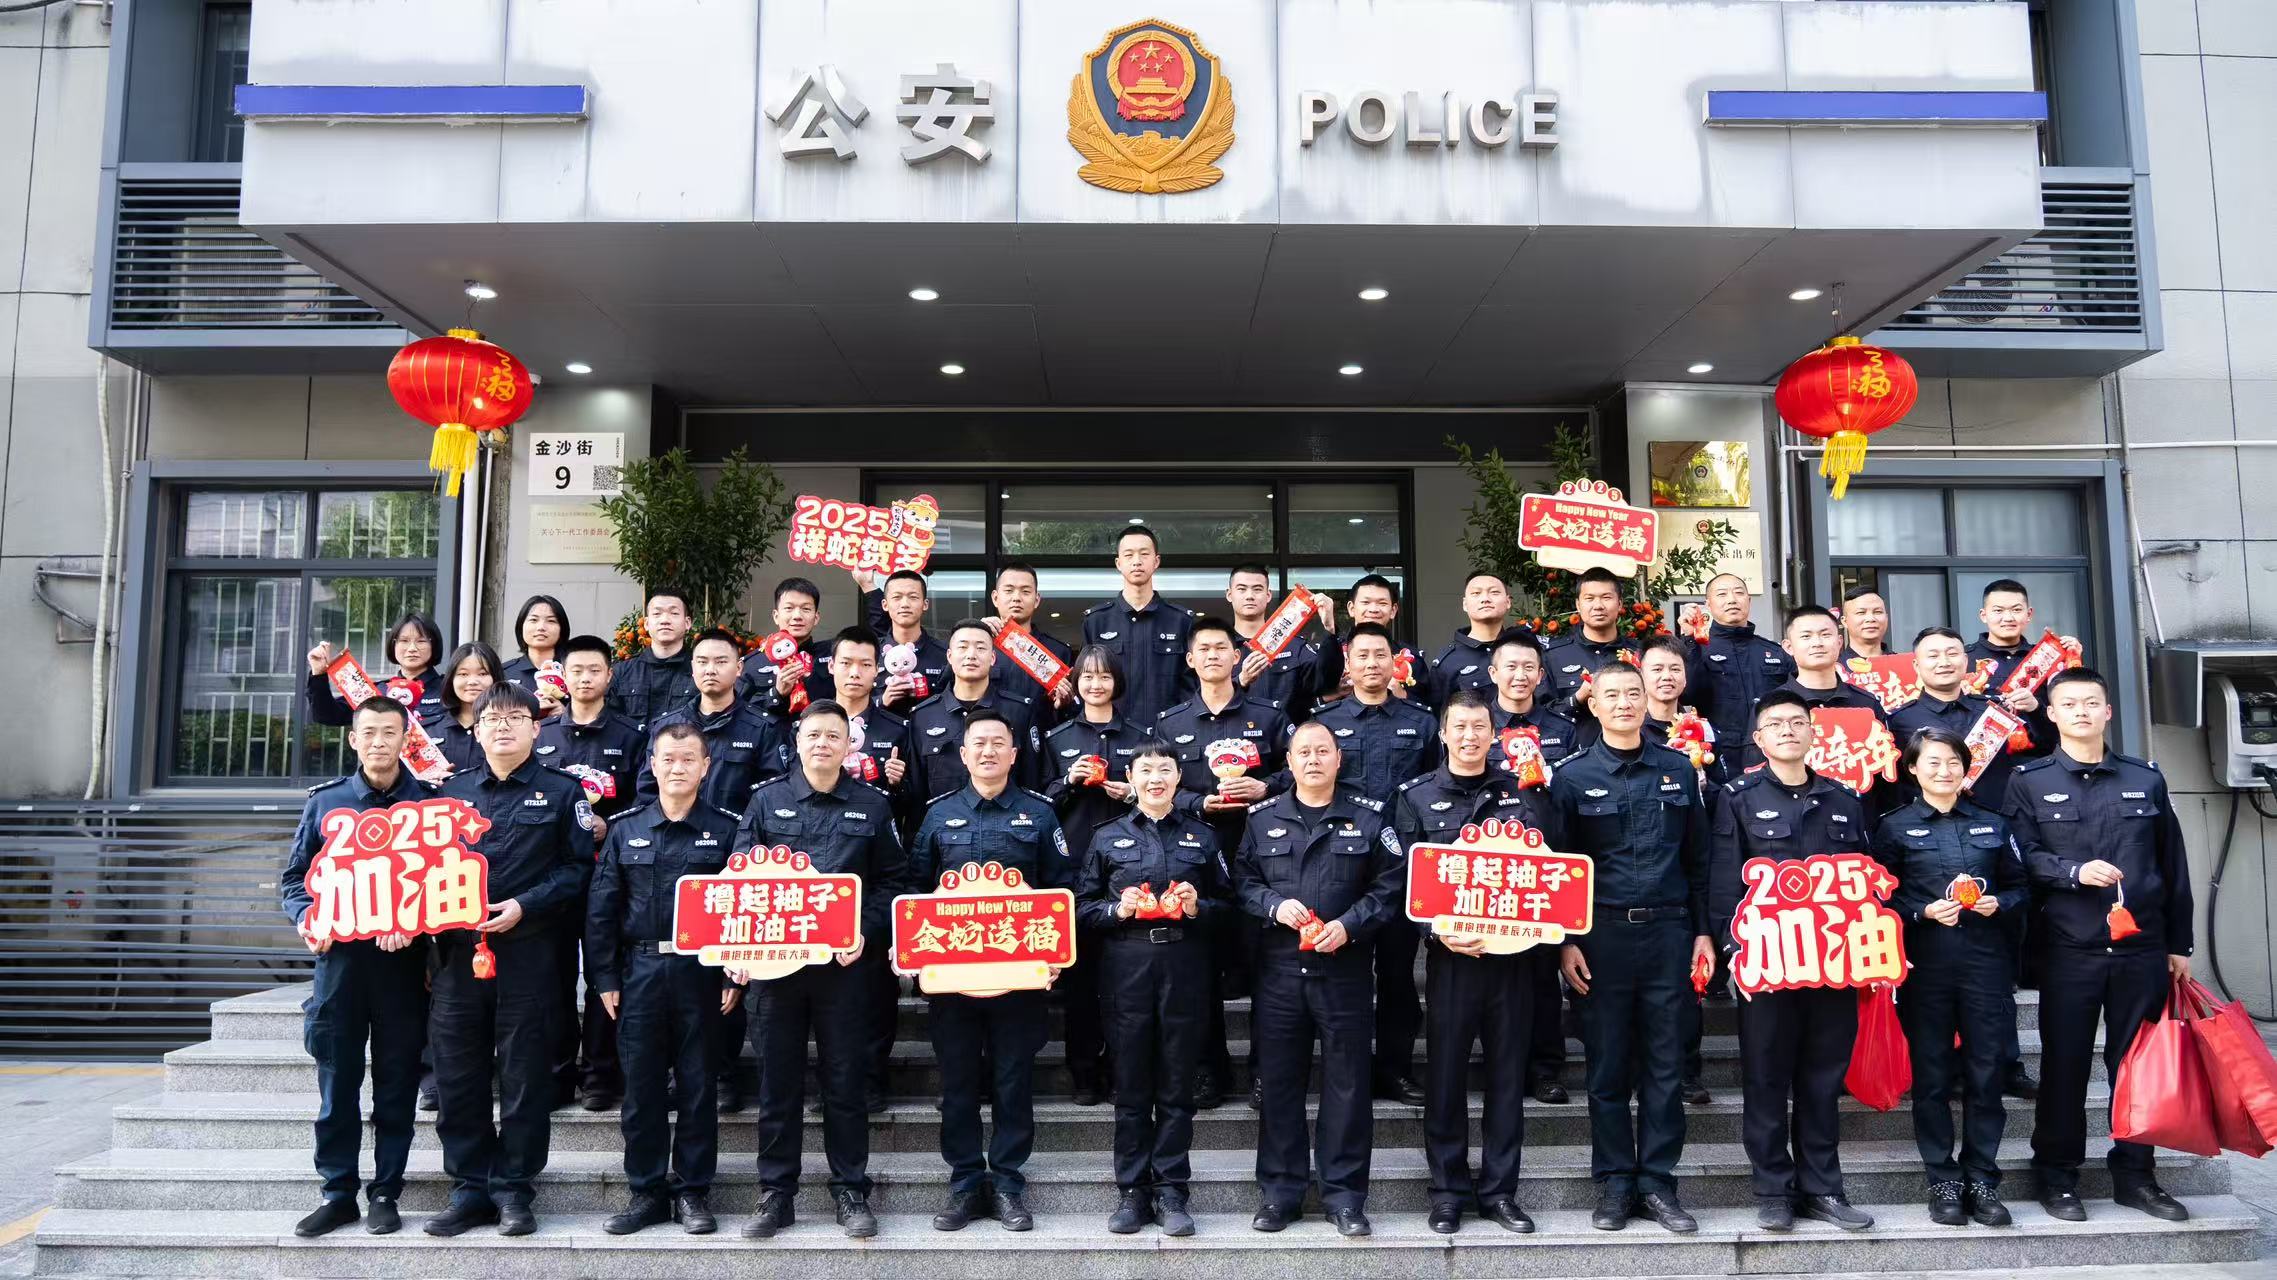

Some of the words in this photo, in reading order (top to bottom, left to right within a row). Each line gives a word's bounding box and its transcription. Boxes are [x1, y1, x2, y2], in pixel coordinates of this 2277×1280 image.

[764, 63, 996, 168] 公安
[1299, 89, 1560, 151] POLICE
[1851, 351, 1892, 398] 福
[535, 440, 593, 456] 金沙街
[555, 465, 571, 490] 9
[1563, 480, 1620, 501] 2025
[797, 500, 890, 537] 2025
[1555, 503, 1585, 516] Happy
[1586, 506, 1607, 518] New
[1607, 509, 1629, 521] Year
[1533, 512, 1647, 553] 金蛇送福
[1853, 672, 1881, 685] 2025
[327, 805, 453, 857] 2025
[1466, 819, 1538, 846] 2025
[732, 847, 806, 870] 2025
[1437, 853, 1572, 892] 撸起袖子
[946, 864, 1017, 887] 2025
[1749, 860, 1868, 906] 2025
[310, 847, 482, 940] 加油
[704, 883, 838, 914] 撸起袖子
[936, 902, 975, 916] Happy
[977, 901, 1004, 914] New
[1005, 899, 1034, 913] Year
[1452, 885, 1552, 921] 加油干
[719, 913, 819, 943] 加油干
[911, 915, 1061, 954] 金蛇送福
[1453, 921, 1496, 935] 拥抱理想
[1500, 925, 1543, 938] 星辰大海
[720, 950, 763, 961] 拥抱理想
[767, 950, 810, 960] 星辰大海
[1737, 902, 1902, 988] 加油
